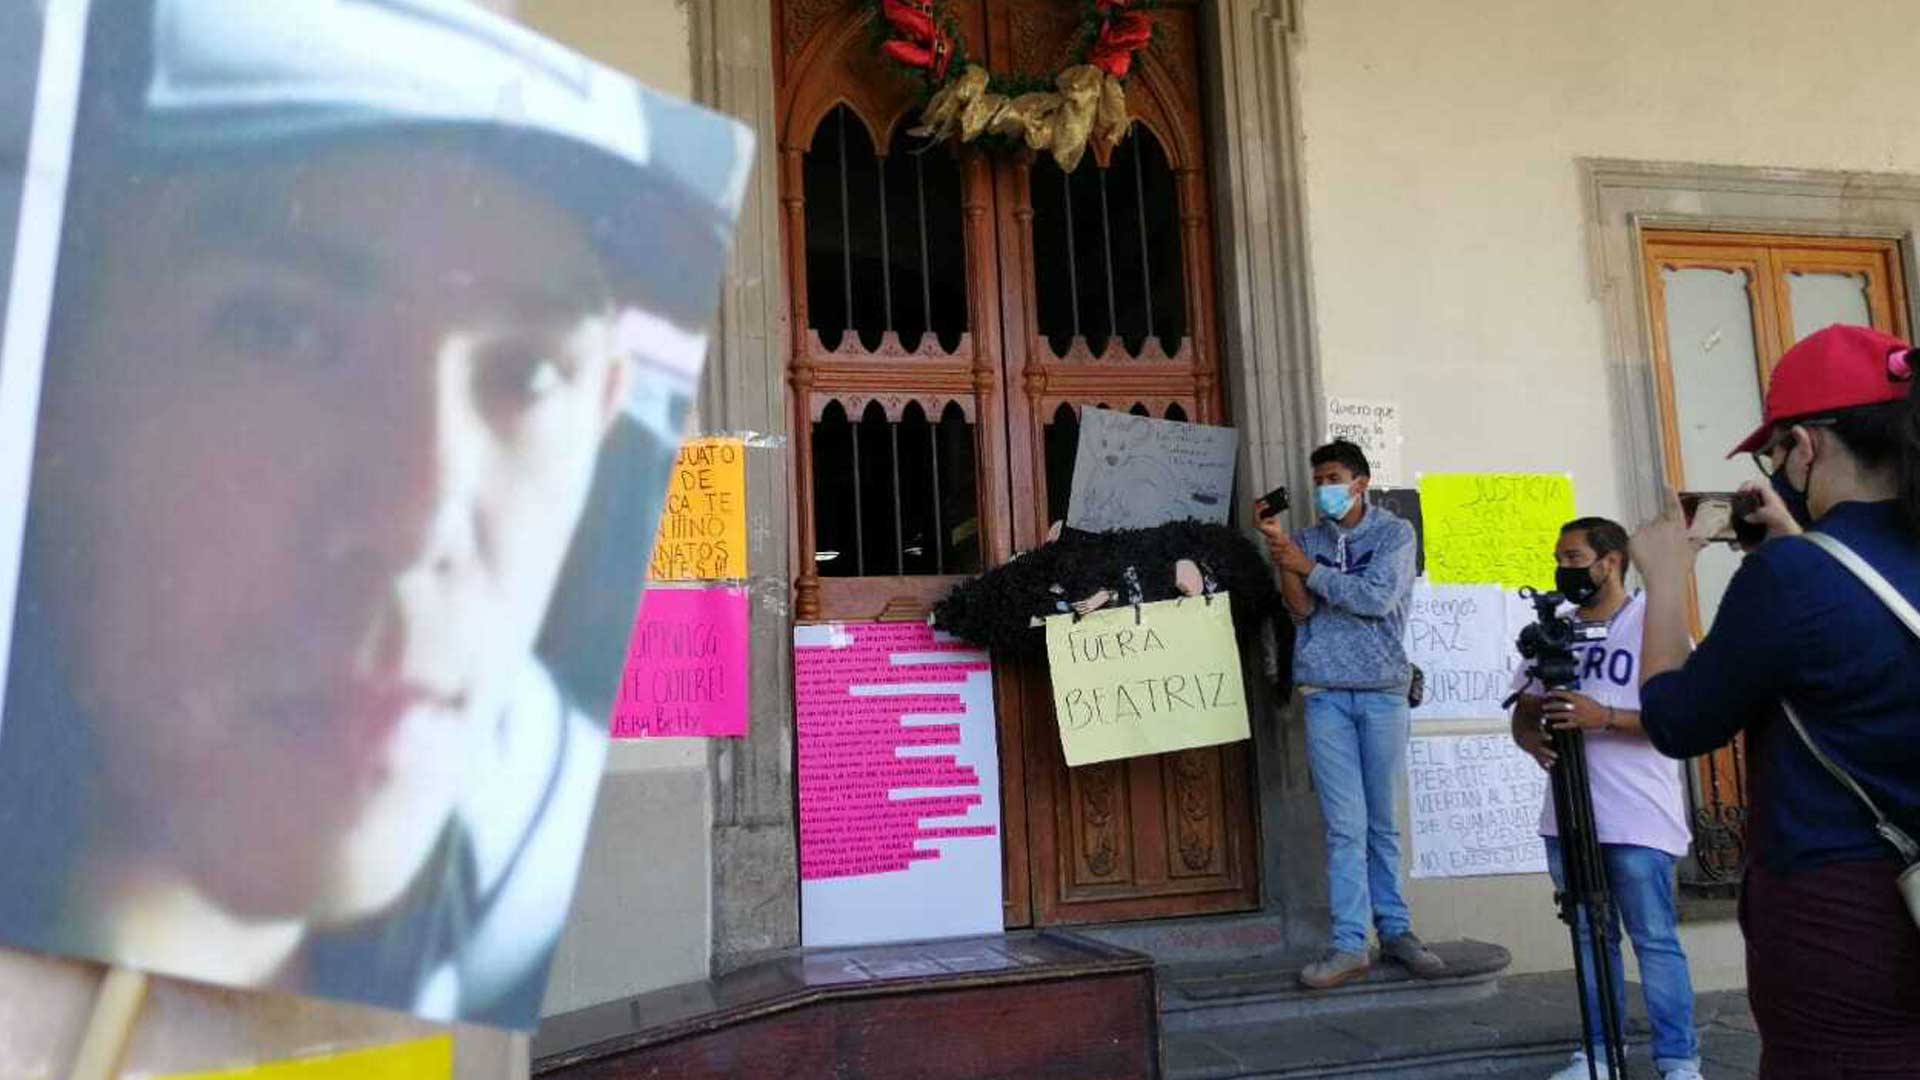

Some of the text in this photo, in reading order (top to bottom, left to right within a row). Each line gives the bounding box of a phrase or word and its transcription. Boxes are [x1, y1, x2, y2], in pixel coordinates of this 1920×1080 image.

[681, 468, 714, 491] DE
[703, 491, 735, 514] TE
[1068, 627, 1166, 664] FUERA
[1408, 617, 1471, 652] PAZ
[1065, 672, 1238, 731] BEATRIZ
[1411, 739, 1450, 765] EL
